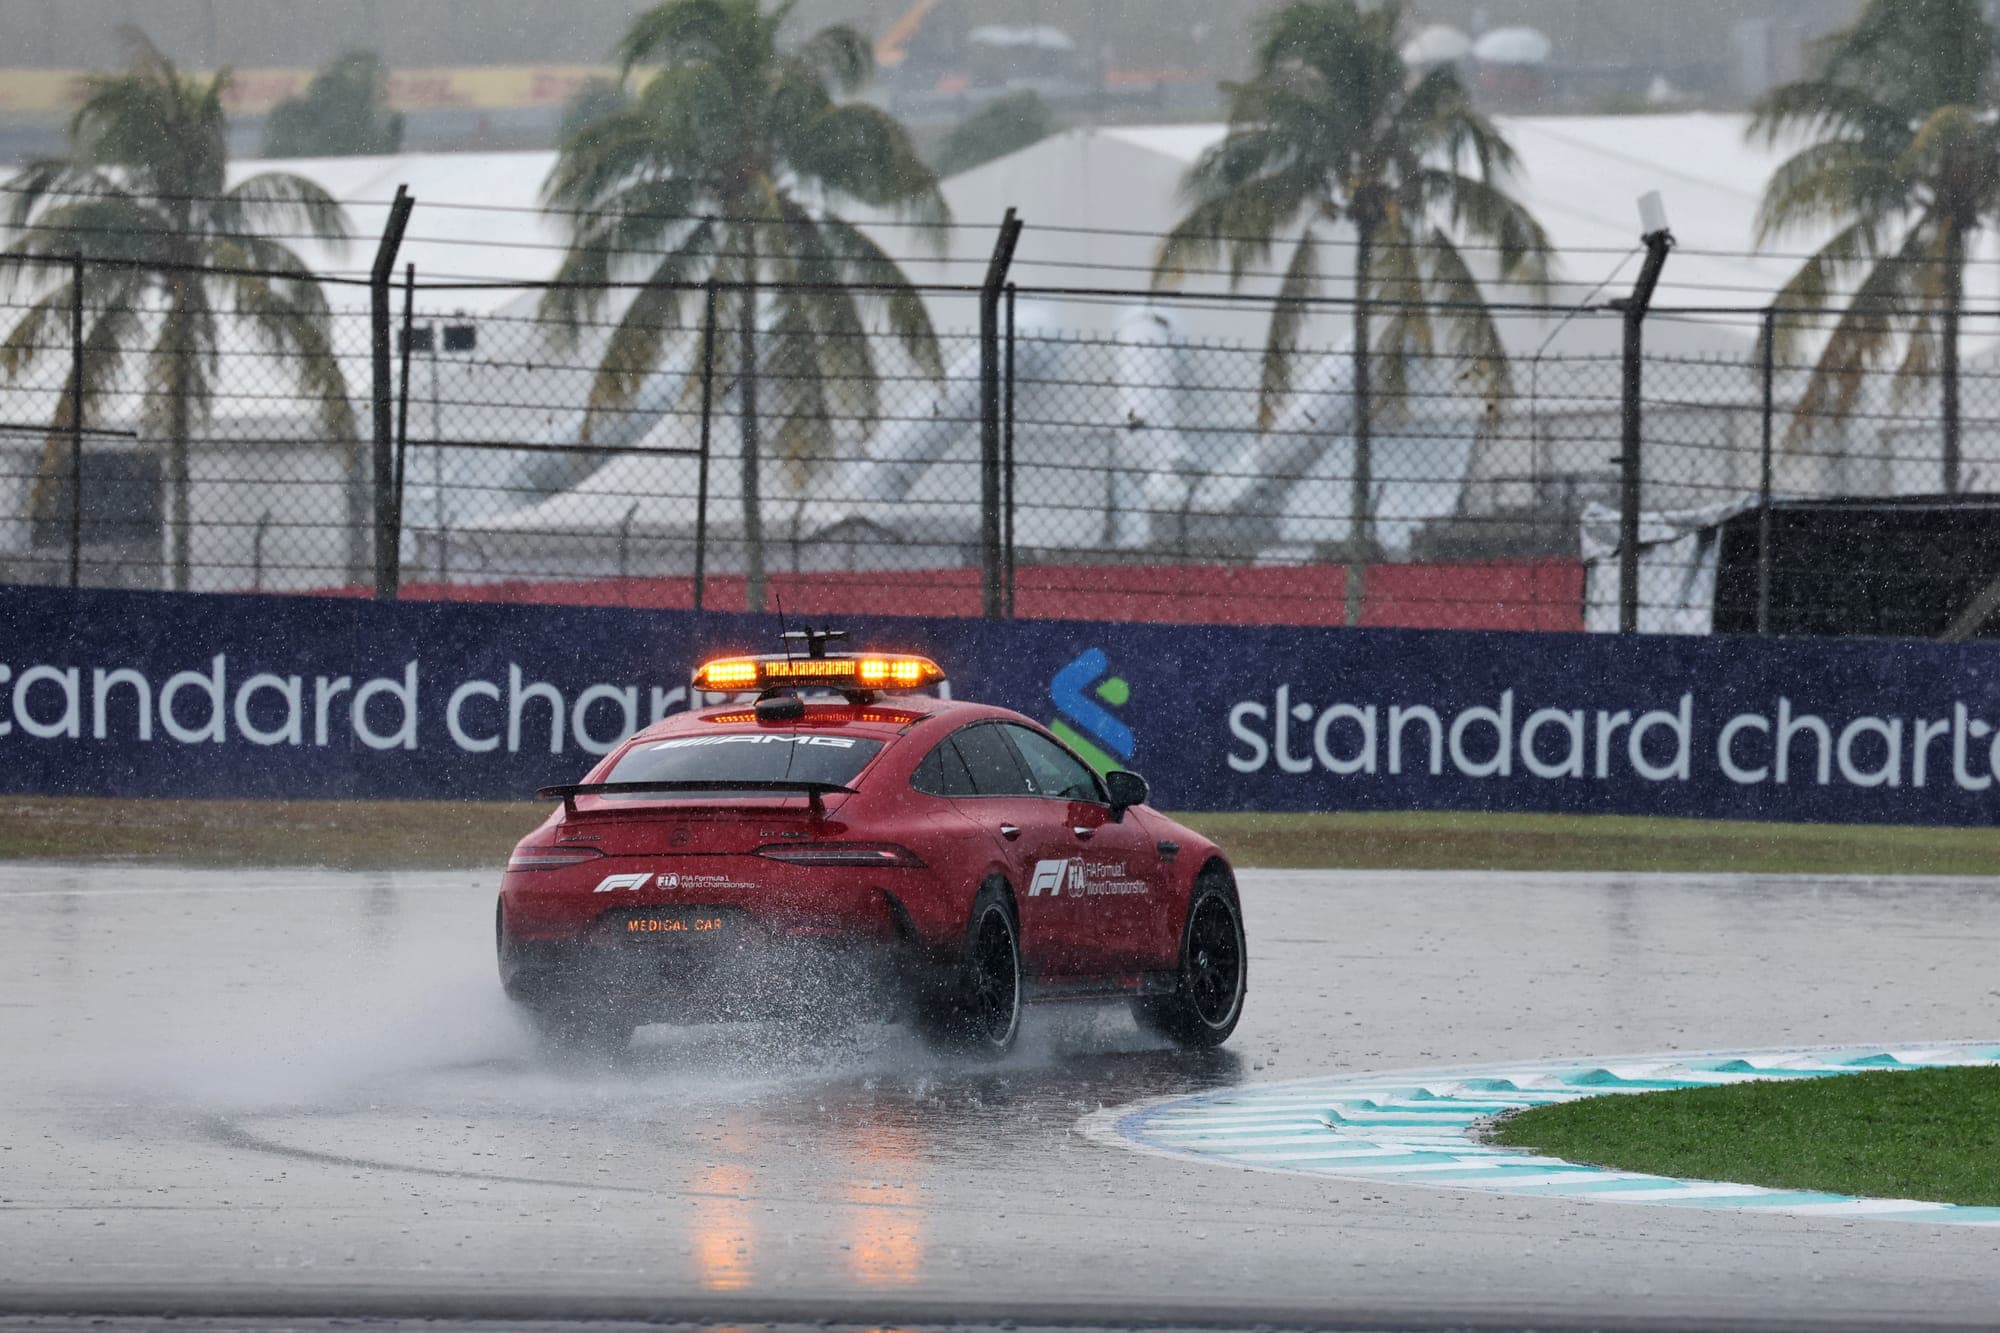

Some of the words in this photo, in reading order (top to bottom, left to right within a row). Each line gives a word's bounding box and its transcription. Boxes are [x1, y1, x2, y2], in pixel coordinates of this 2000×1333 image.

[1227, 684, 1692, 780] standard
[1717, 696, 2000, 791] chart
[593, 873, 654, 893] F1
[703, 881, 755, 889] Championship
[1028, 859, 1068, 896] F1
[627, 919, 688, 932] MEDICAL
[694, 918, 722, 931] CAR
